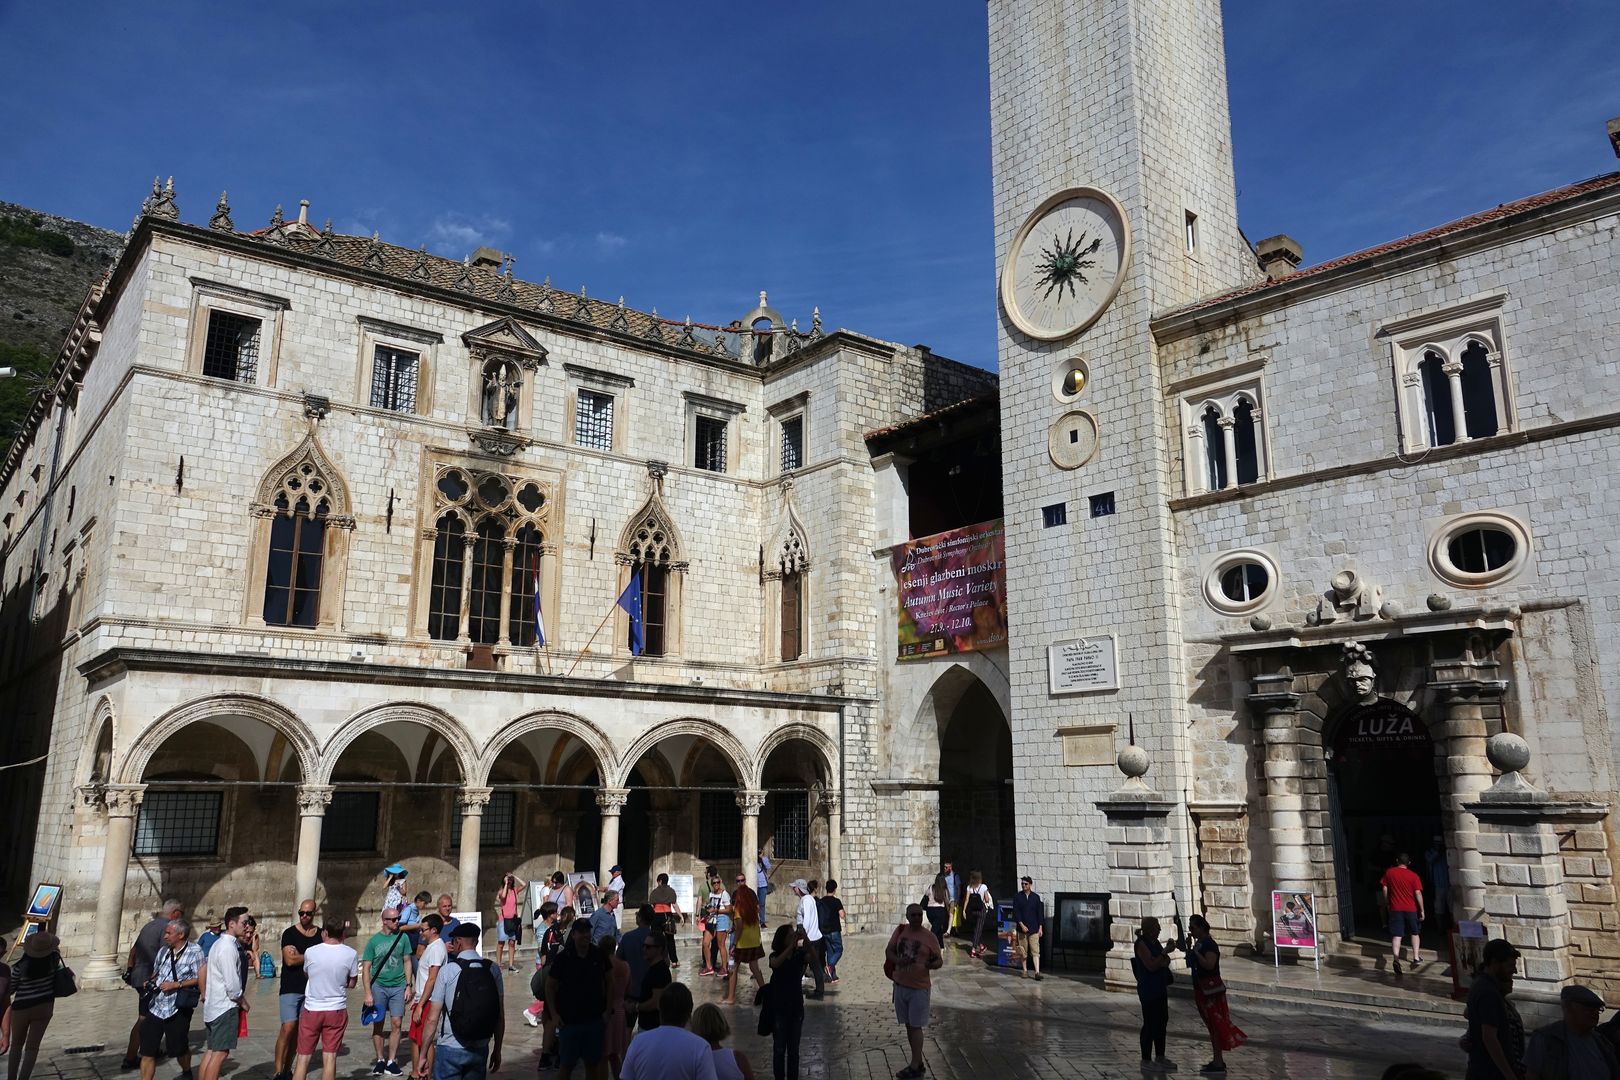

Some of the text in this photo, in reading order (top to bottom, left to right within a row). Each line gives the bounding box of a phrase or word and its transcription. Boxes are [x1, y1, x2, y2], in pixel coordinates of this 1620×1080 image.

[947, 533, 979, 548] simfonijski
[930, 565, 966, 586] glazbeni
[903, 579, 998, 609] Autumn Music Variety
[948, 603, 969, 613] Rector's
[969, 599, 989, 608] Palace
[929, 623, 945, 634] 27.9.
[951, 616, 972, 630] 12.10.
[1358, 713, 1414, 736] LUŽA
